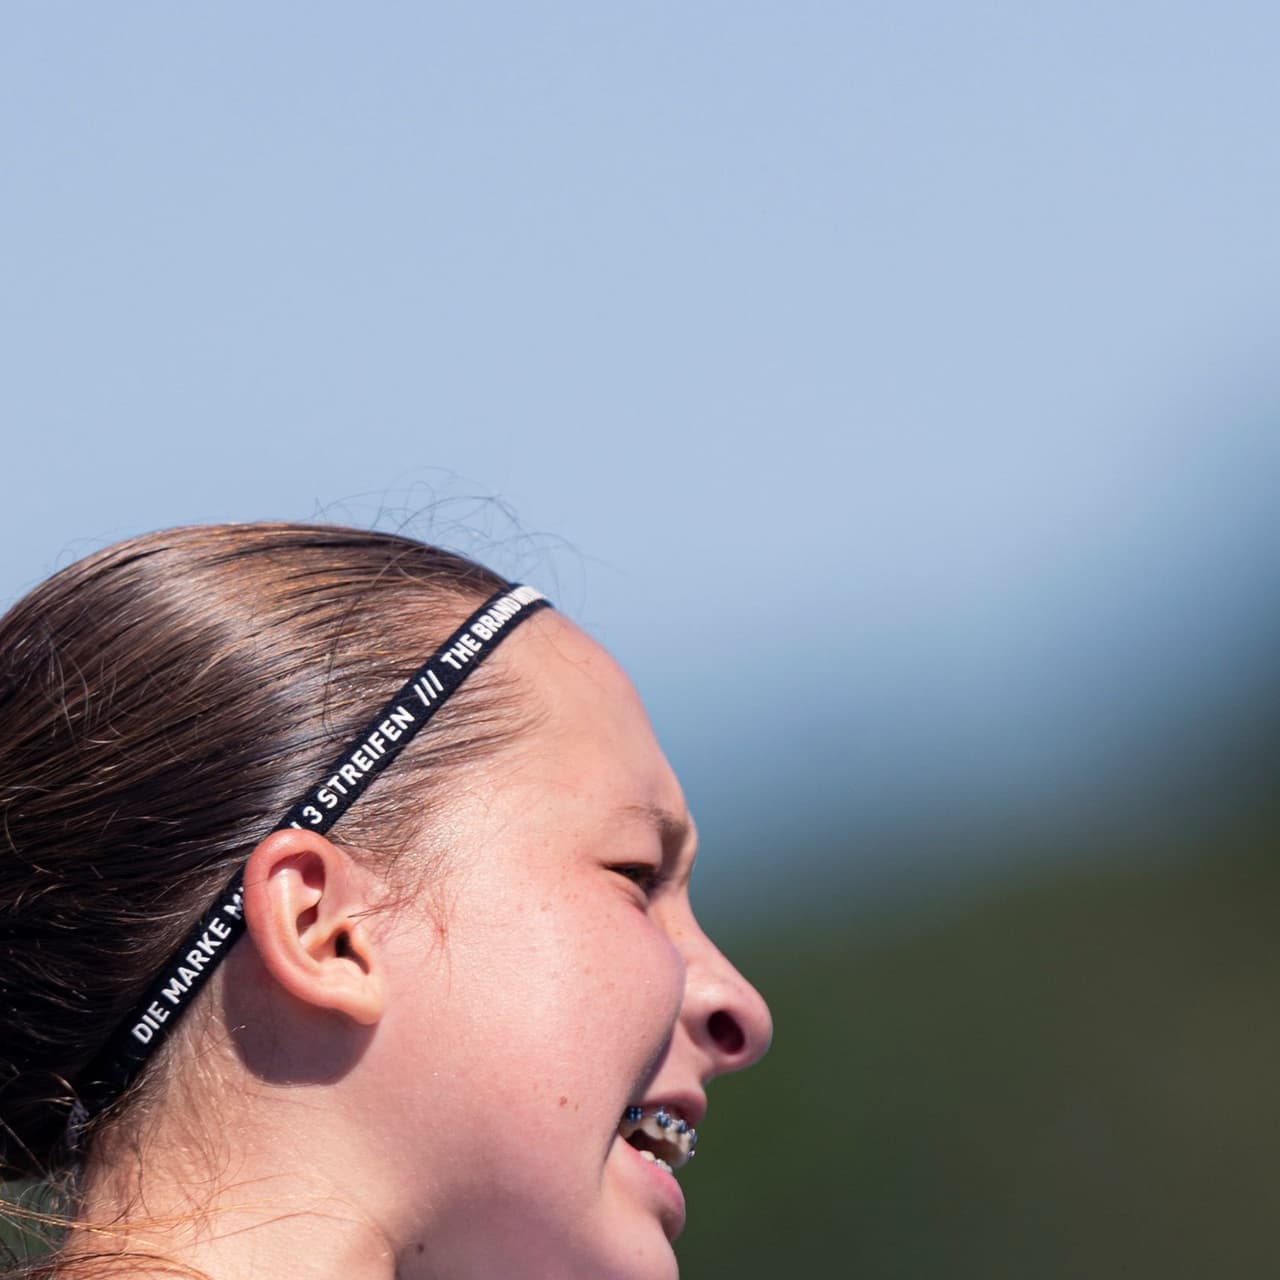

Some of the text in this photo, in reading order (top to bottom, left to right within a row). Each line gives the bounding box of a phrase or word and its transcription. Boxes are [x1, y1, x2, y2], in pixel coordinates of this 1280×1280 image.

[131, 1001, 170, 1044] DIE
[161, 918, 232, 1005] MARKE
[302, 806, 323, 825] 3
[317, 705, 415, 808] STREIFEN
[440, 633, 483, 670] THE
